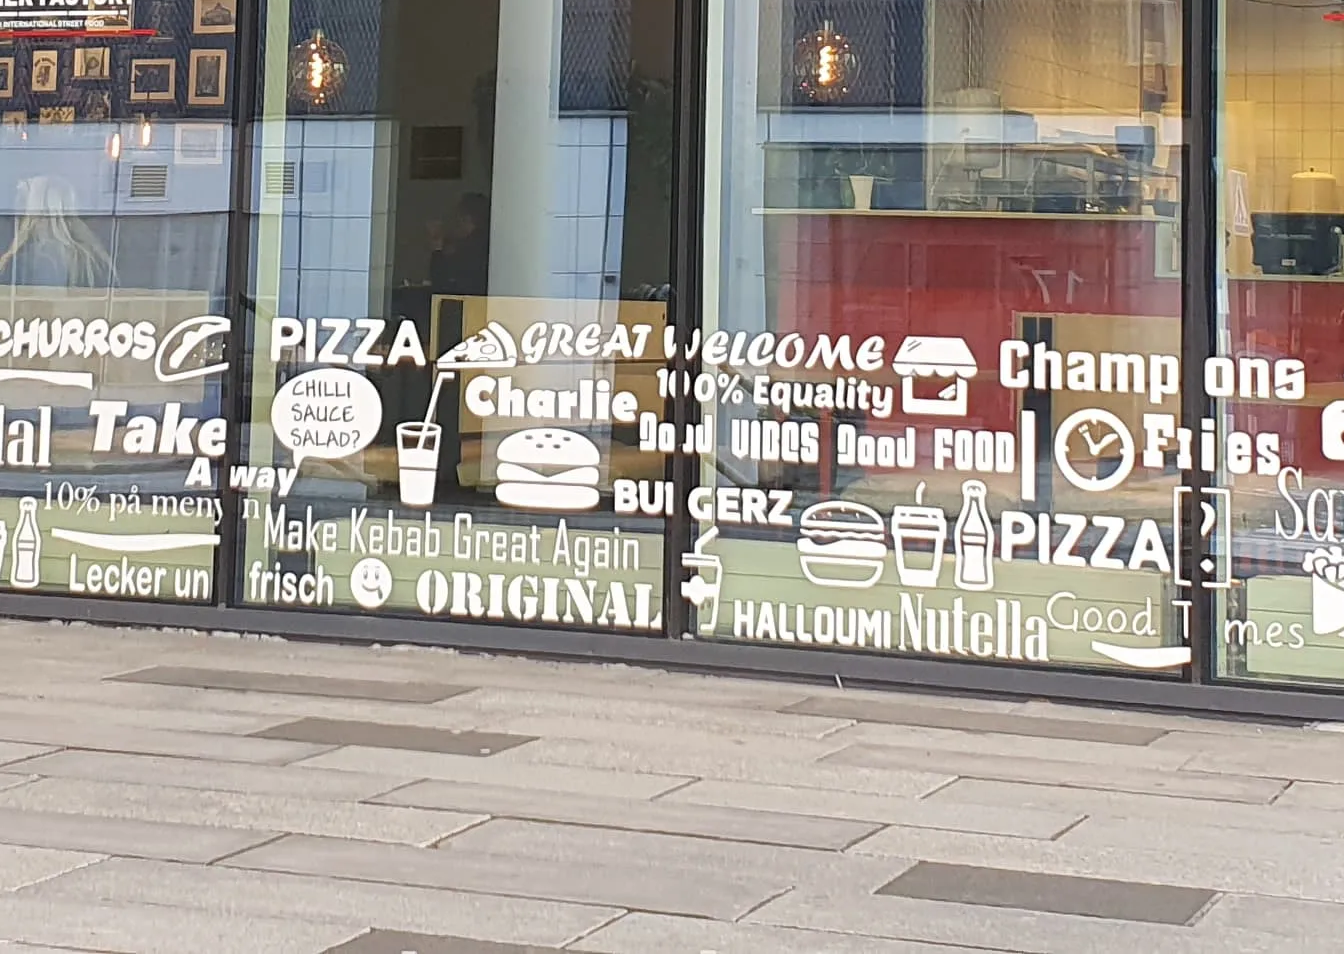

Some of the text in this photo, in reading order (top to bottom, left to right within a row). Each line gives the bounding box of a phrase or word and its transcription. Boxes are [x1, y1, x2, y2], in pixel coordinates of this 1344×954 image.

[270, 317, 427, 367] PIZZA
[521, 322, 885, 372] GREAT WELCOME
[292, 379, 351, 398] CHILLI
[656, 367, 893, 418] 100% Equality
[999, 340, 1305, 405] Champons
[291, 403, 355, 423] SAUCE
[464, 375, 639, 422] Charlie
[89, 399, 228, 457] Take
[290, 428, 360, 448] SALAD?
[933, 427, 1015, 473] FOOD
[1143, 413, 1281, 476] Fries
[43, 480, 101, 516] 10%
[109, 484, 142, 522] på
[263, 504, 641, 578] Make Kebab Great Again
[1000, 510, 1173, 573] PIZZA
[69, 553, 167, 596] Lecker
[248, 560, 334, 606] frisch
[416, 569, 662, 631] ORIGINAL
[733, 599, 892, 648] HALLOUMI
[1046, 591, 1306, 649] Good Tmes
[898, 592, 1050, 662] Nutella
